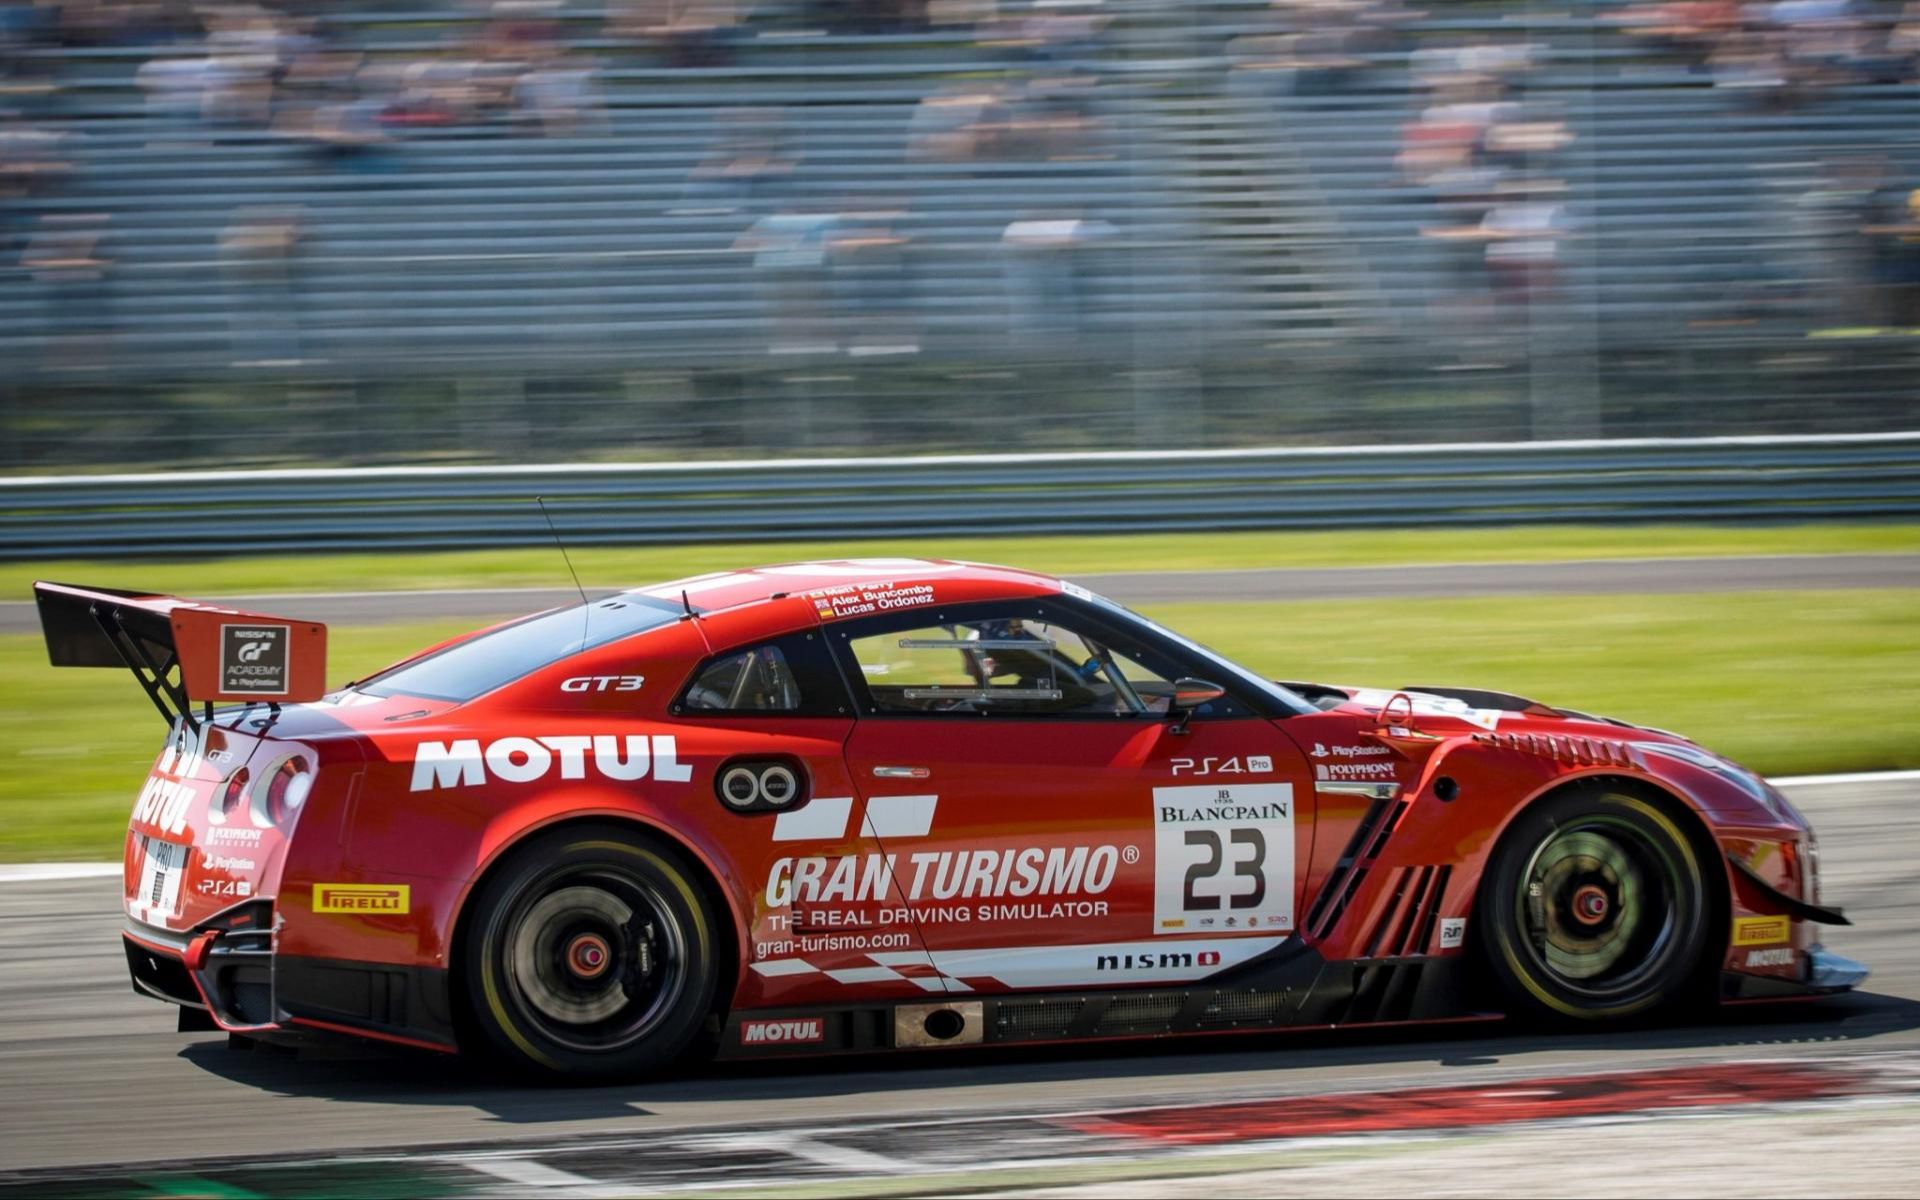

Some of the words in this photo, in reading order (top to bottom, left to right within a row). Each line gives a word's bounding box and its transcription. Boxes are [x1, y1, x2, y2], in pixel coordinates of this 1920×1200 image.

[831, 594, 861, 607] Alex
[863, 585, 934, 601] Buncombe
[856, 581, 894, 592] Parry
[834, 601, 875, 617] Lucas
[878, 594, 934, 609] Ordonez
[226, 665, 282, 675] ACADEMY
[560, 675, 645, 692] GT3
[1331, 745, 1390, 758] PlayStation
[410, 734, 693, 792] MOTUL
[1170, 756, 1246, 776] PS4
[1251, 760, 1269, 770] Pro
[1329, 762, 1395, 775] POLYPHONY
[1330, 771, 1396, 780] DIGITAL
[1160, 802, 1288, 823] BLANCPAIN
[1183, 828, 1266, 911] 23
[202, 879, 235, 896] PS4
[765, 853, 897, 908] GRAN
[321, 889, 400, 909] PIRELLI
[768, 911, 803, 931] THE
[811, 909, 873, 927] REAL
[879, 905, 971, 925] DRIVING
[977, 901, 1109, 922] SIMULATOR
[756, 932, 911, 959] gran-turismo.com
[745, 1021, 821, 1041] MOTUL
